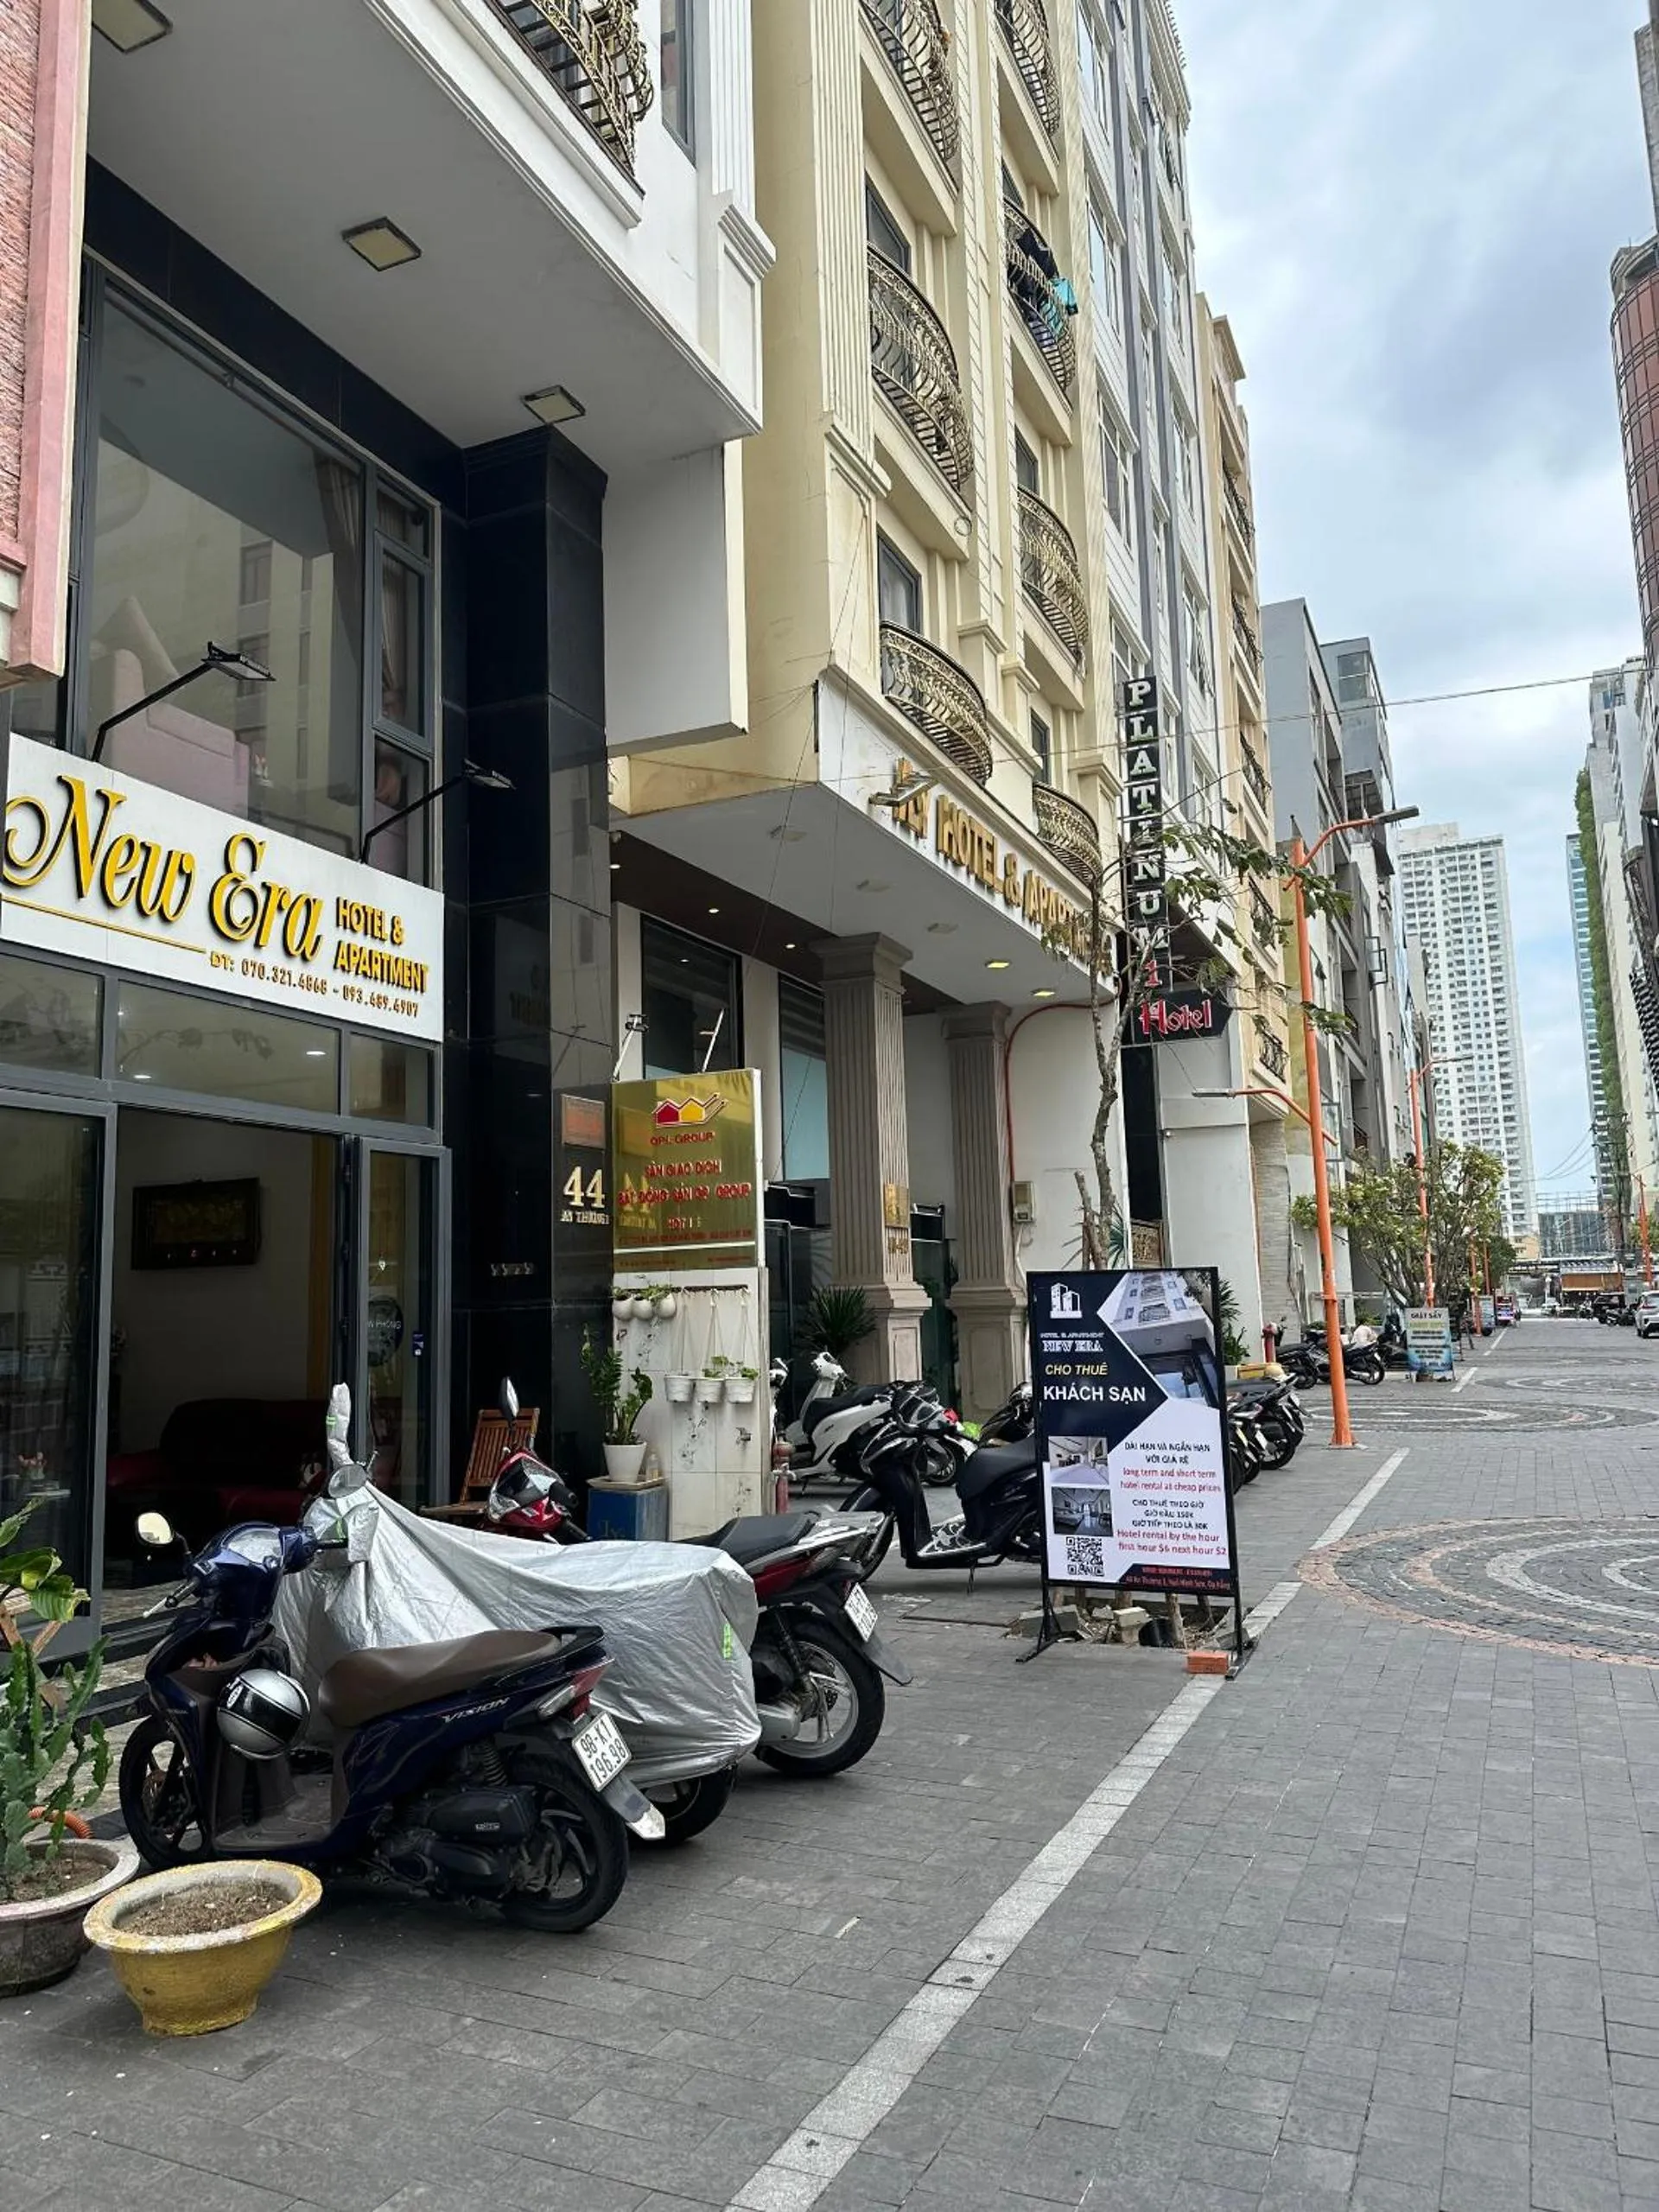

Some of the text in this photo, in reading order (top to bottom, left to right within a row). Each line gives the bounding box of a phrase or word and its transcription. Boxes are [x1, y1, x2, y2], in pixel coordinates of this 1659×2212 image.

[1128, 680, 1170, 950] PLATINUM
[937, 793, 1004, 895] HOTEL
[1004, 853, 1022, 908] &
[2, 774, 324, 963] New Era
[335, 896, 405, 945] HOTEL &
[241, 957, 327, 996] 070.321.4868
[334, 939, 429, 995] APARTMENT
[1141, 959, 1163, 988] 1
[1138, 997, 1212, 1035] Hotel
[675, 1130, 715, 1145] GROUP
[666, 1162, 693, 1177] GIAO
[563, 1166, 606, 1209] 44
[715, 1182, 752, 1199] GROUP
[1042, 1339, 1103, 1352] NEW ERA
[1045, 1362, 1109, 1376] CHO THUÊ
[1043, 1382, 1146, 1405] KHÁCH SẠN
[1123, 1467, 1217, 1478] long term and short term
[1120, 1480, 1140, 1491] hotel
[1141, 1481, 1163, 1491] rental
[1173, 1482, 1198, 1492] cheap
[1198, 1483, 1222, 1494] prices
[1117, 1529, 1220, 1542] Hotel rental by the hour
[1118, 1541, 1135, 1551] first
[1136, 1542, 1157, 1552] hour
[1172, 1546, 1192, 1554] next
[1192, 1546, 1214, 1555] hour
[442, 1696, 511, 1724] VISION
[589, 1738, 626, 1783] 196.98
